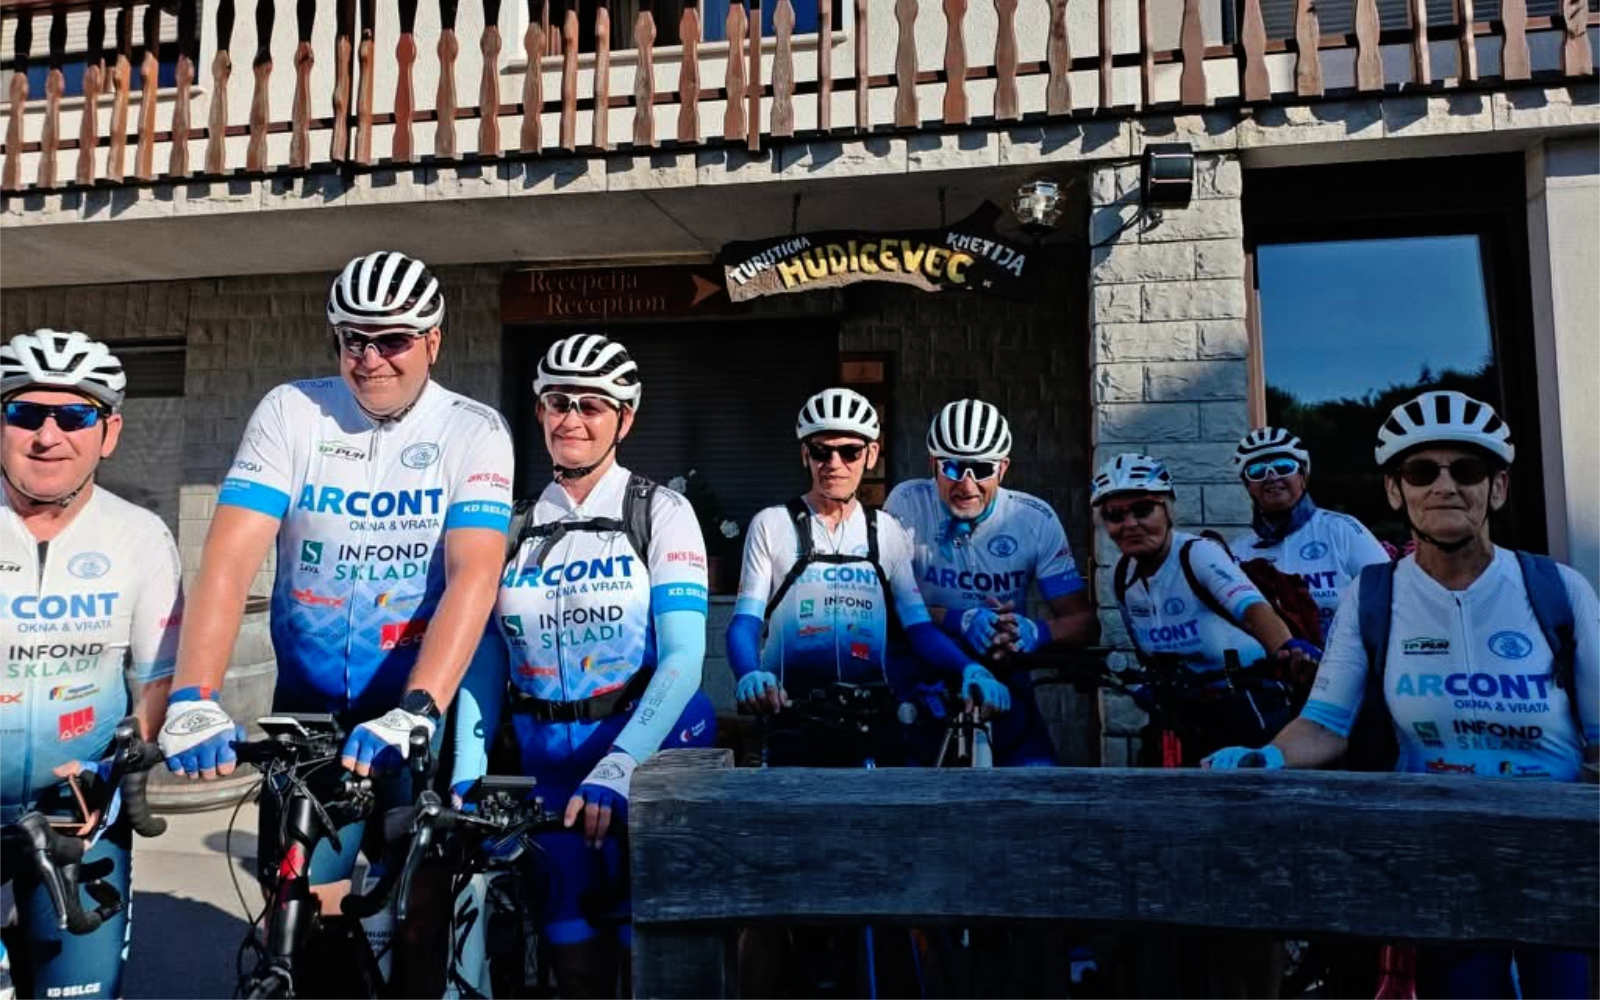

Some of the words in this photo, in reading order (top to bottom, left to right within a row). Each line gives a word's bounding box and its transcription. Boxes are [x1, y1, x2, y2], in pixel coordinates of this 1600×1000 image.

[946, 232, 1025, 277] KMETIJA
[547, 291, 666, 320] Reception
[297, 483, 443, 518] ARCONT
[349, 520, 385, 532] OKNA
[400, 518, 440, 532] VRATA
[338, 542, 429, 562] INFOND
[335, 560, 428, 581] SKLADI
[500, 554, 634, 588] ARCONT
[923, 564, 1026, 593] ARCONT
[591, 580, 633, 593] VRATA
[824, 595, 873, 611] INFOND
[17, 622, 58, 633] OKNA
[539, 604, 624, 630] INFOND
[541, 623, 624, 650] SKLADI
[9, 643, 104, 661] INFOND
[7, 657, 100, 679] SKLADI
[1395, 672, 1551, 700] ARCONT
[1454, 699, 1492, 712] OKNA
[1508, 702, 1551, 714] VRATA
[59, 720, 95, 741] ACO
[1452, 719, 1543, 741] INFOND
